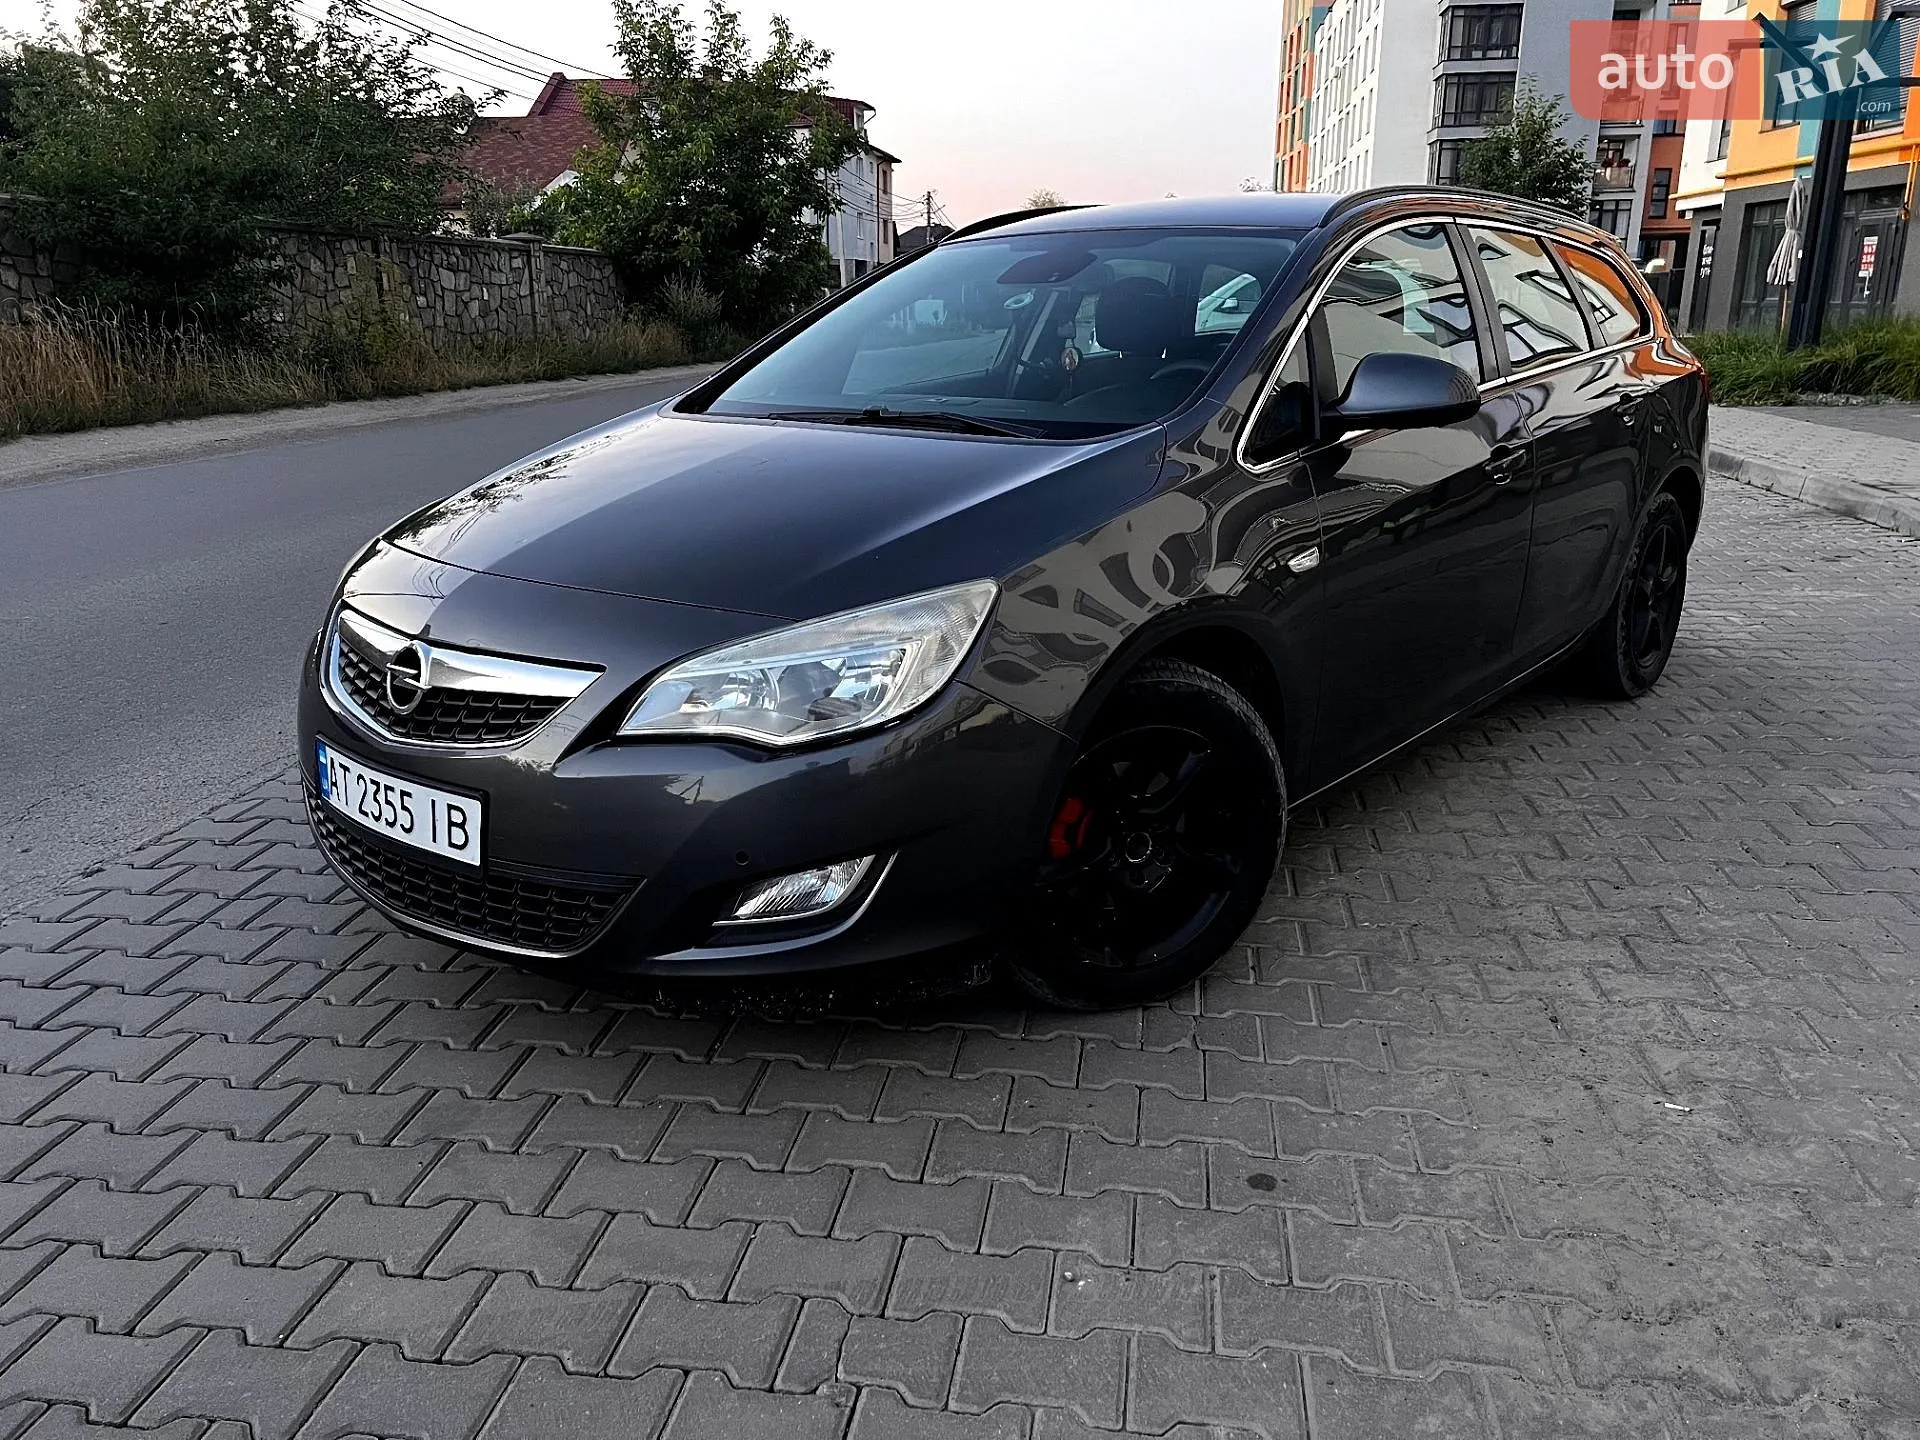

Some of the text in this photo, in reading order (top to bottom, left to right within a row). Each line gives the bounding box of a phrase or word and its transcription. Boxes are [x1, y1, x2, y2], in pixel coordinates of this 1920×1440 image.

[329, 756, 470, 851] AT 2355 IB
